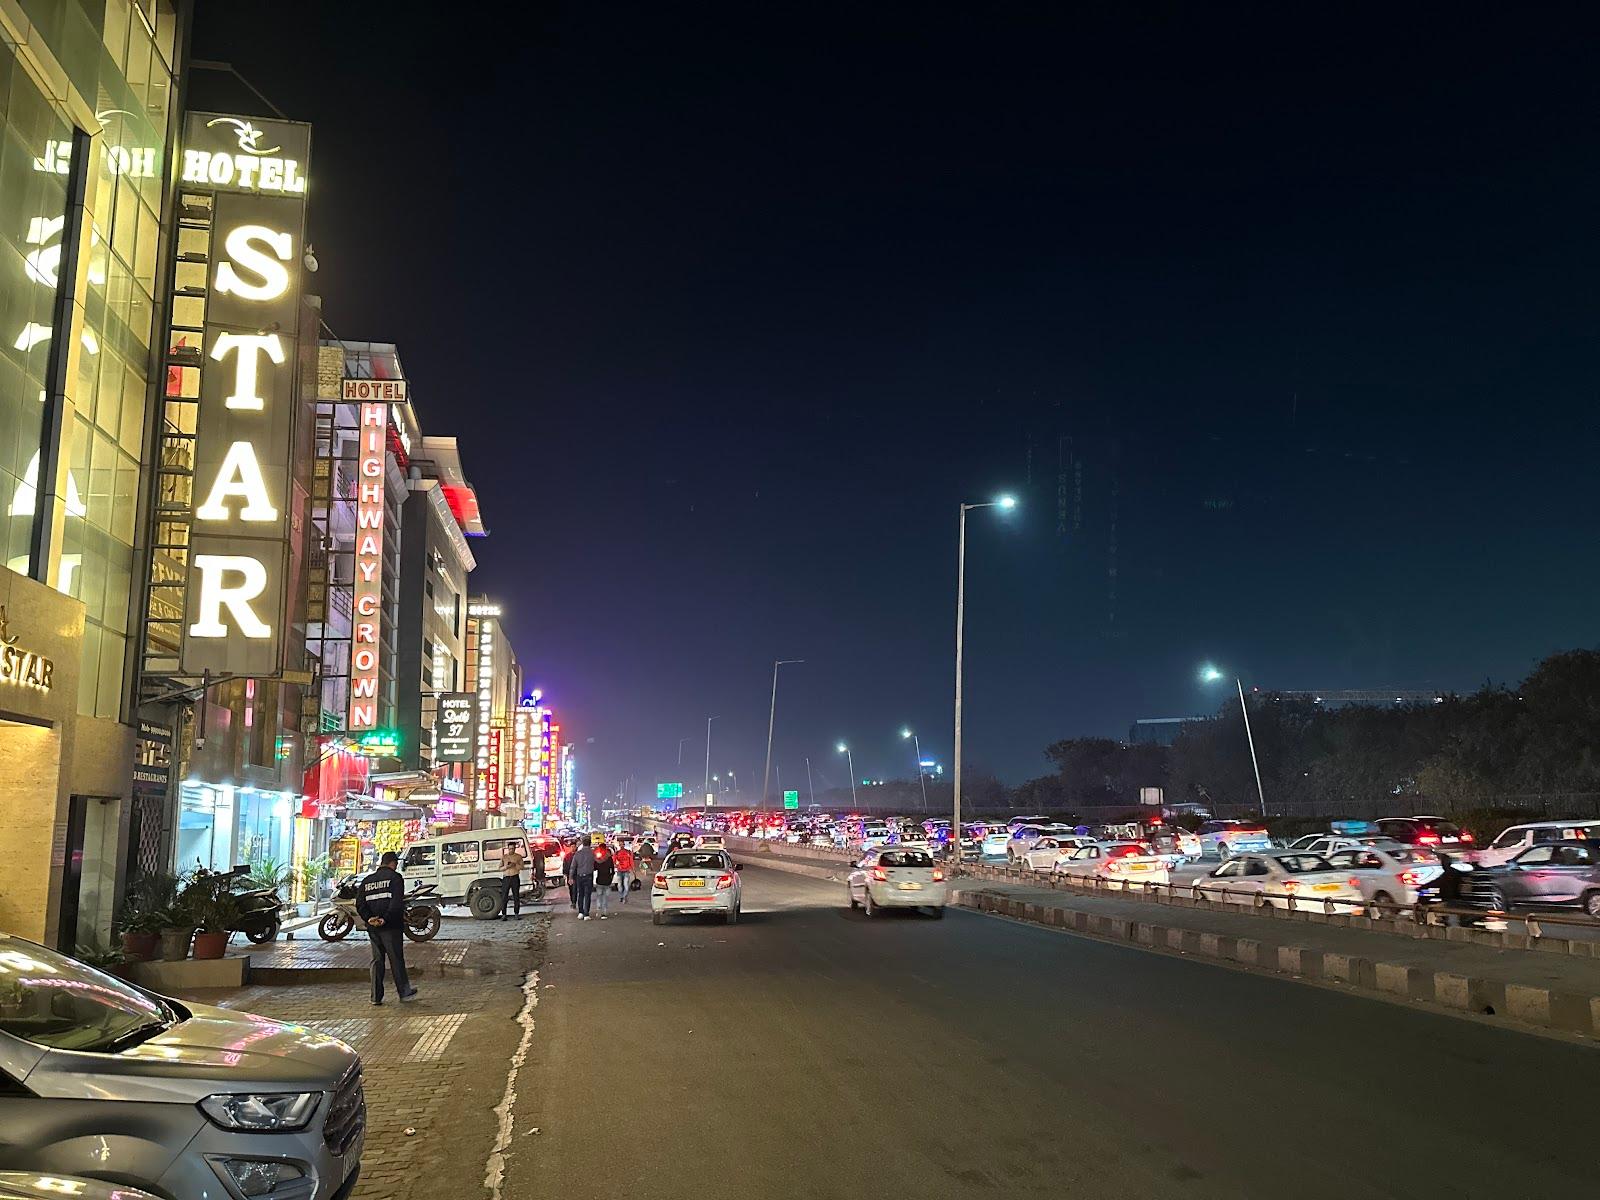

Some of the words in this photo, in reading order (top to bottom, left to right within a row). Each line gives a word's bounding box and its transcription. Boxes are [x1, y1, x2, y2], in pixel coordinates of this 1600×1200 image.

[182, 149, 305, 193] HOTEL
[345, 382, 404, 399] HOTEL
[189, 224, 293, 640] STAR
[357, 406, 383, 583] HIGHWAY
[0, 646, 54, 689] STAR
[351, 595, 376, 728] CROWN
[443, 700, 471, 708] HOTEL
[447, 724, 464, 737] 37
[364, 879, 392, 892] SECURITY
